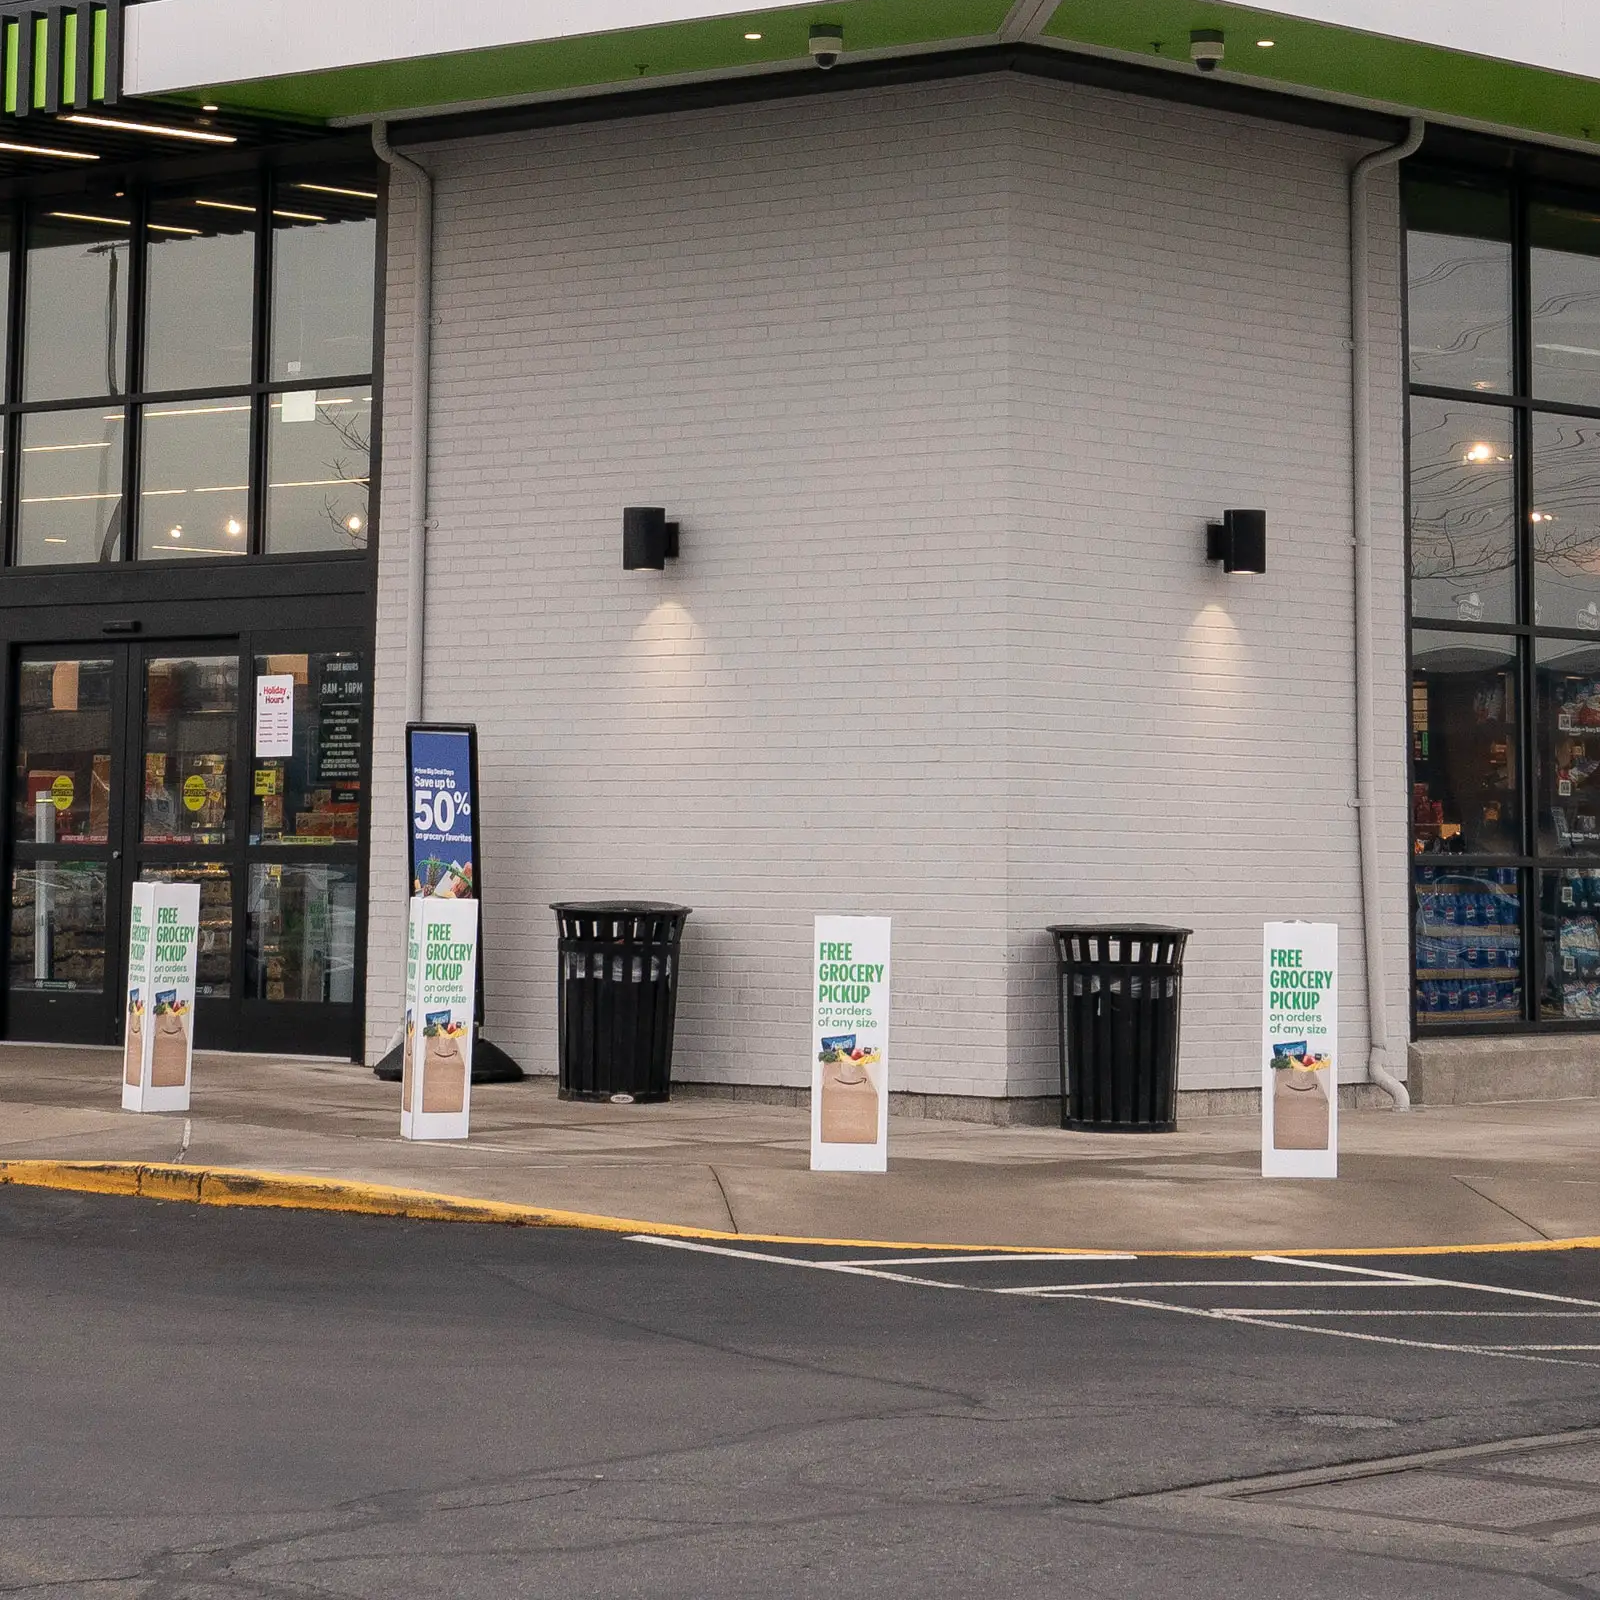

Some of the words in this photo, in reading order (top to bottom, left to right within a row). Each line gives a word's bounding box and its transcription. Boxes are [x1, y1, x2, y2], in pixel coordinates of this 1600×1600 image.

[263, 686, 287, 696] Holiday
[322, 683, 338, 694] 8AM
[345, 682, 363, 693] 10PM
[265, 696, 284, 704] Hours
[415, 776, 433, 787] Save
[435, 780, 445, 790] up
[446, 778, 456, 788] to
[414, 790, 471, 832] 50%
[423, 834, 444, 842] grocery
[445, 833, 472, 842] favorites
[158, 908, 178, 923] FREE
[157, 927, 195, 942] GROCERY
[428, 924, 451, 940] FREE
[156, 945, 186, 961] PICKUP
[426, 944, 473, 960] GROCERY
[820, 943, 852, 960] FREE
[1271, 949, 1302, 967] FREE
[165, 964, 187, 972] orders
[425, 963, 462, 980] PICKUP
[819, 964, 884, 982] GROCERY
[154, 974, 161, 983] of
[163, 976, 175, 984] any
[1270, 970, 1333, 989] GROCERY
[437, 983, 463, 992] orders
[819, 985, 870, 1003] PICKUP
[424, 994, 432, 1003] of
[434, 996, 449, 1005] any
[451, 994, 467, 1003] size
[1270, 991, 1320, 1009] PICKUP
[835, 1005, 872, 1015] orders
[1287, 1012, 1322, 1022] orders
[818, 1017, 829, 1026] of
[832, 1019, 853, 1030] any
[856, 1018, 877, 1027] size
[1270, 1024, 1281, 1033] of
[1283, 1026, 1304, 1036] any
[1307, 1024, 1326, 1033] size
